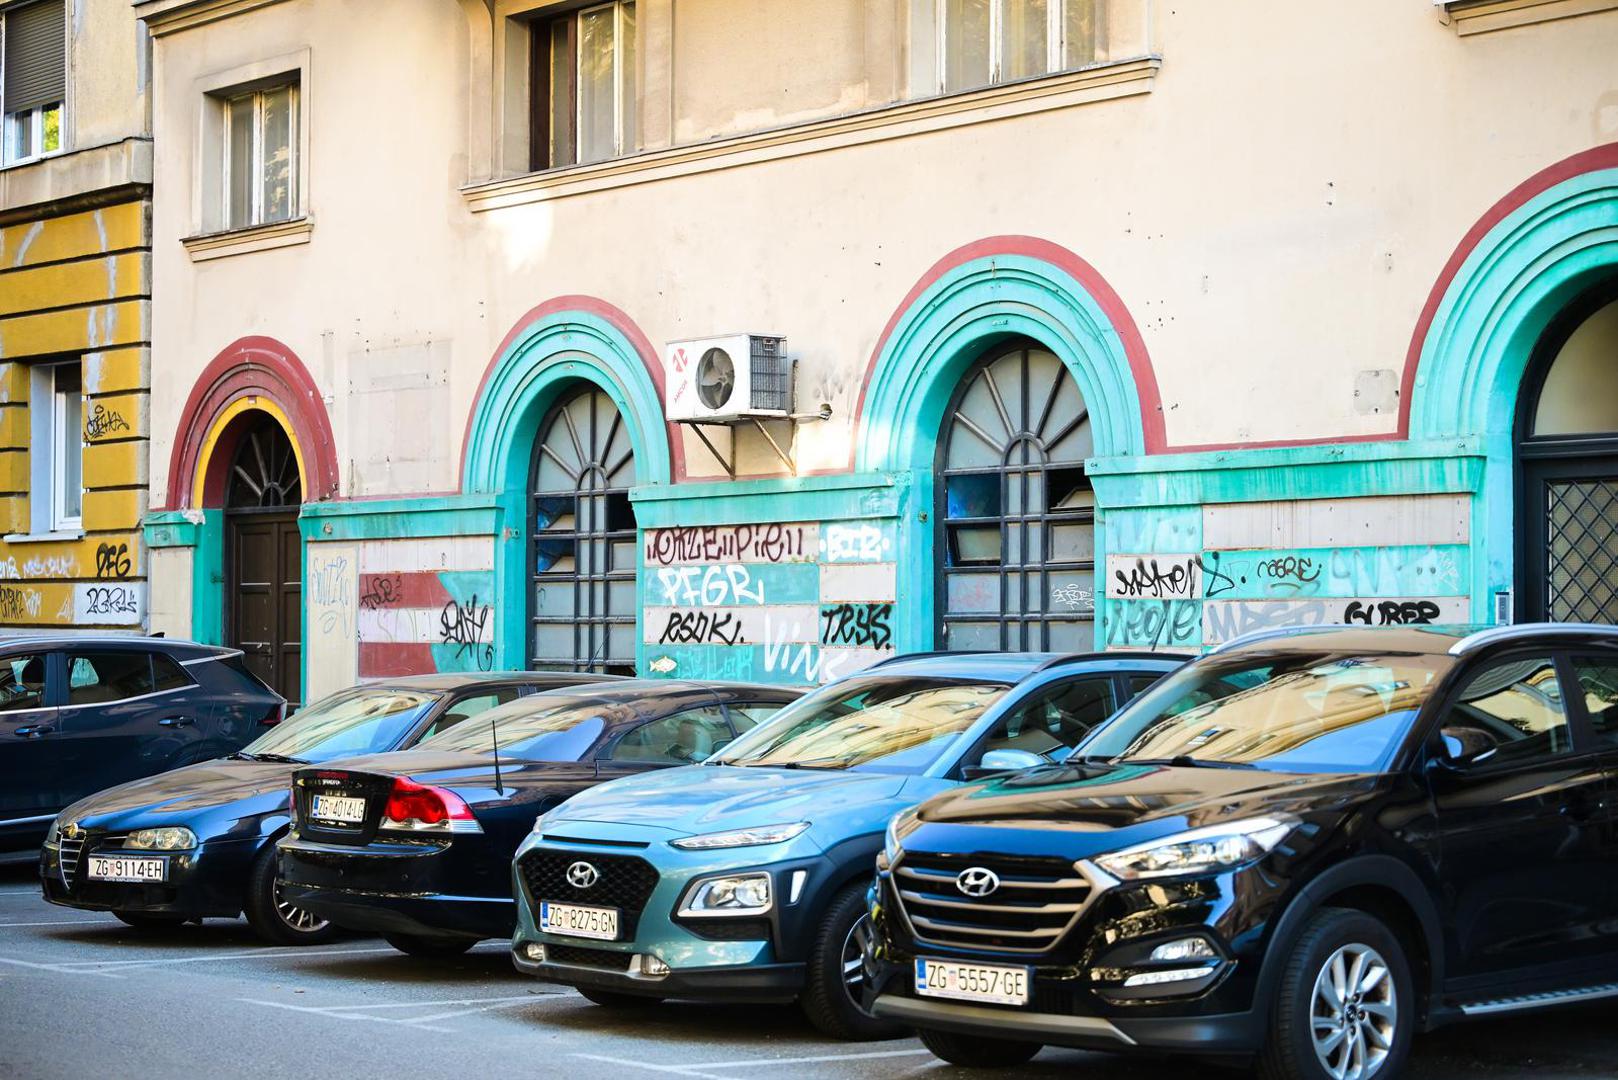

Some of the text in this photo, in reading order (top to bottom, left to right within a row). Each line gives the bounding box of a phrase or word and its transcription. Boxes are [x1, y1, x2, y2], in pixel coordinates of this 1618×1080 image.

[318, 798, 329, 816] ZG
[95, 859, 109, 876] ZG
[549, 906, 563, 927] ZG
[928, 964, 947, 989] ZG
